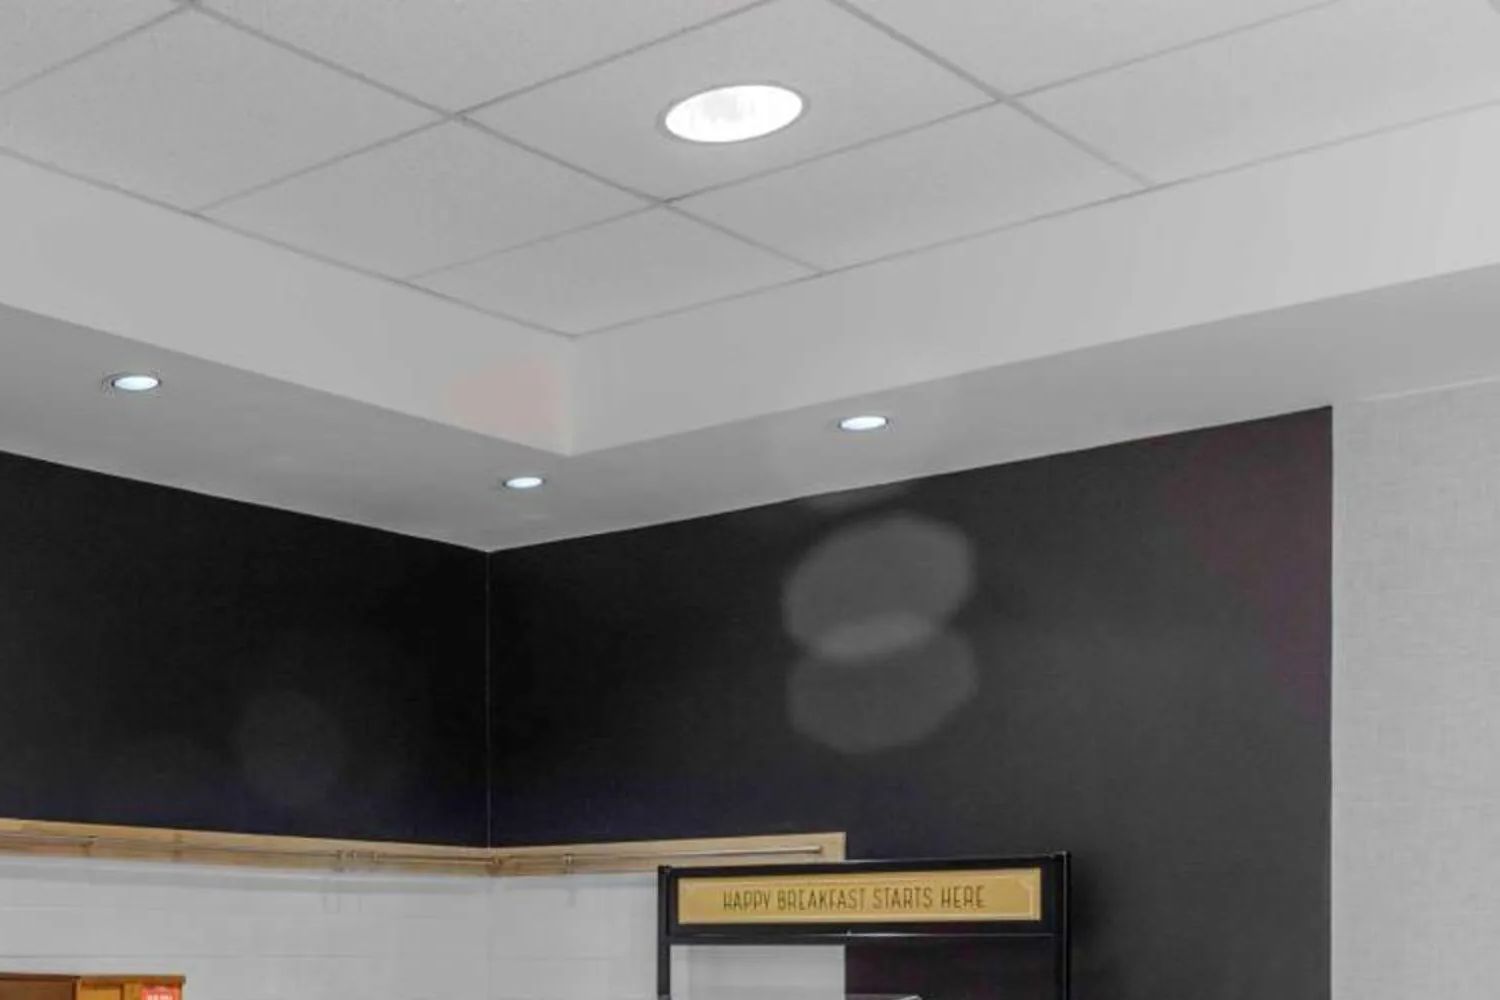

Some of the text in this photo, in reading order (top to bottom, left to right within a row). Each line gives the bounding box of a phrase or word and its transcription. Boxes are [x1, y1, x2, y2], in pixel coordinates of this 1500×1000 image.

[722, 885, 988, 912] HAPPY BREAKFAST STARTS HERE
